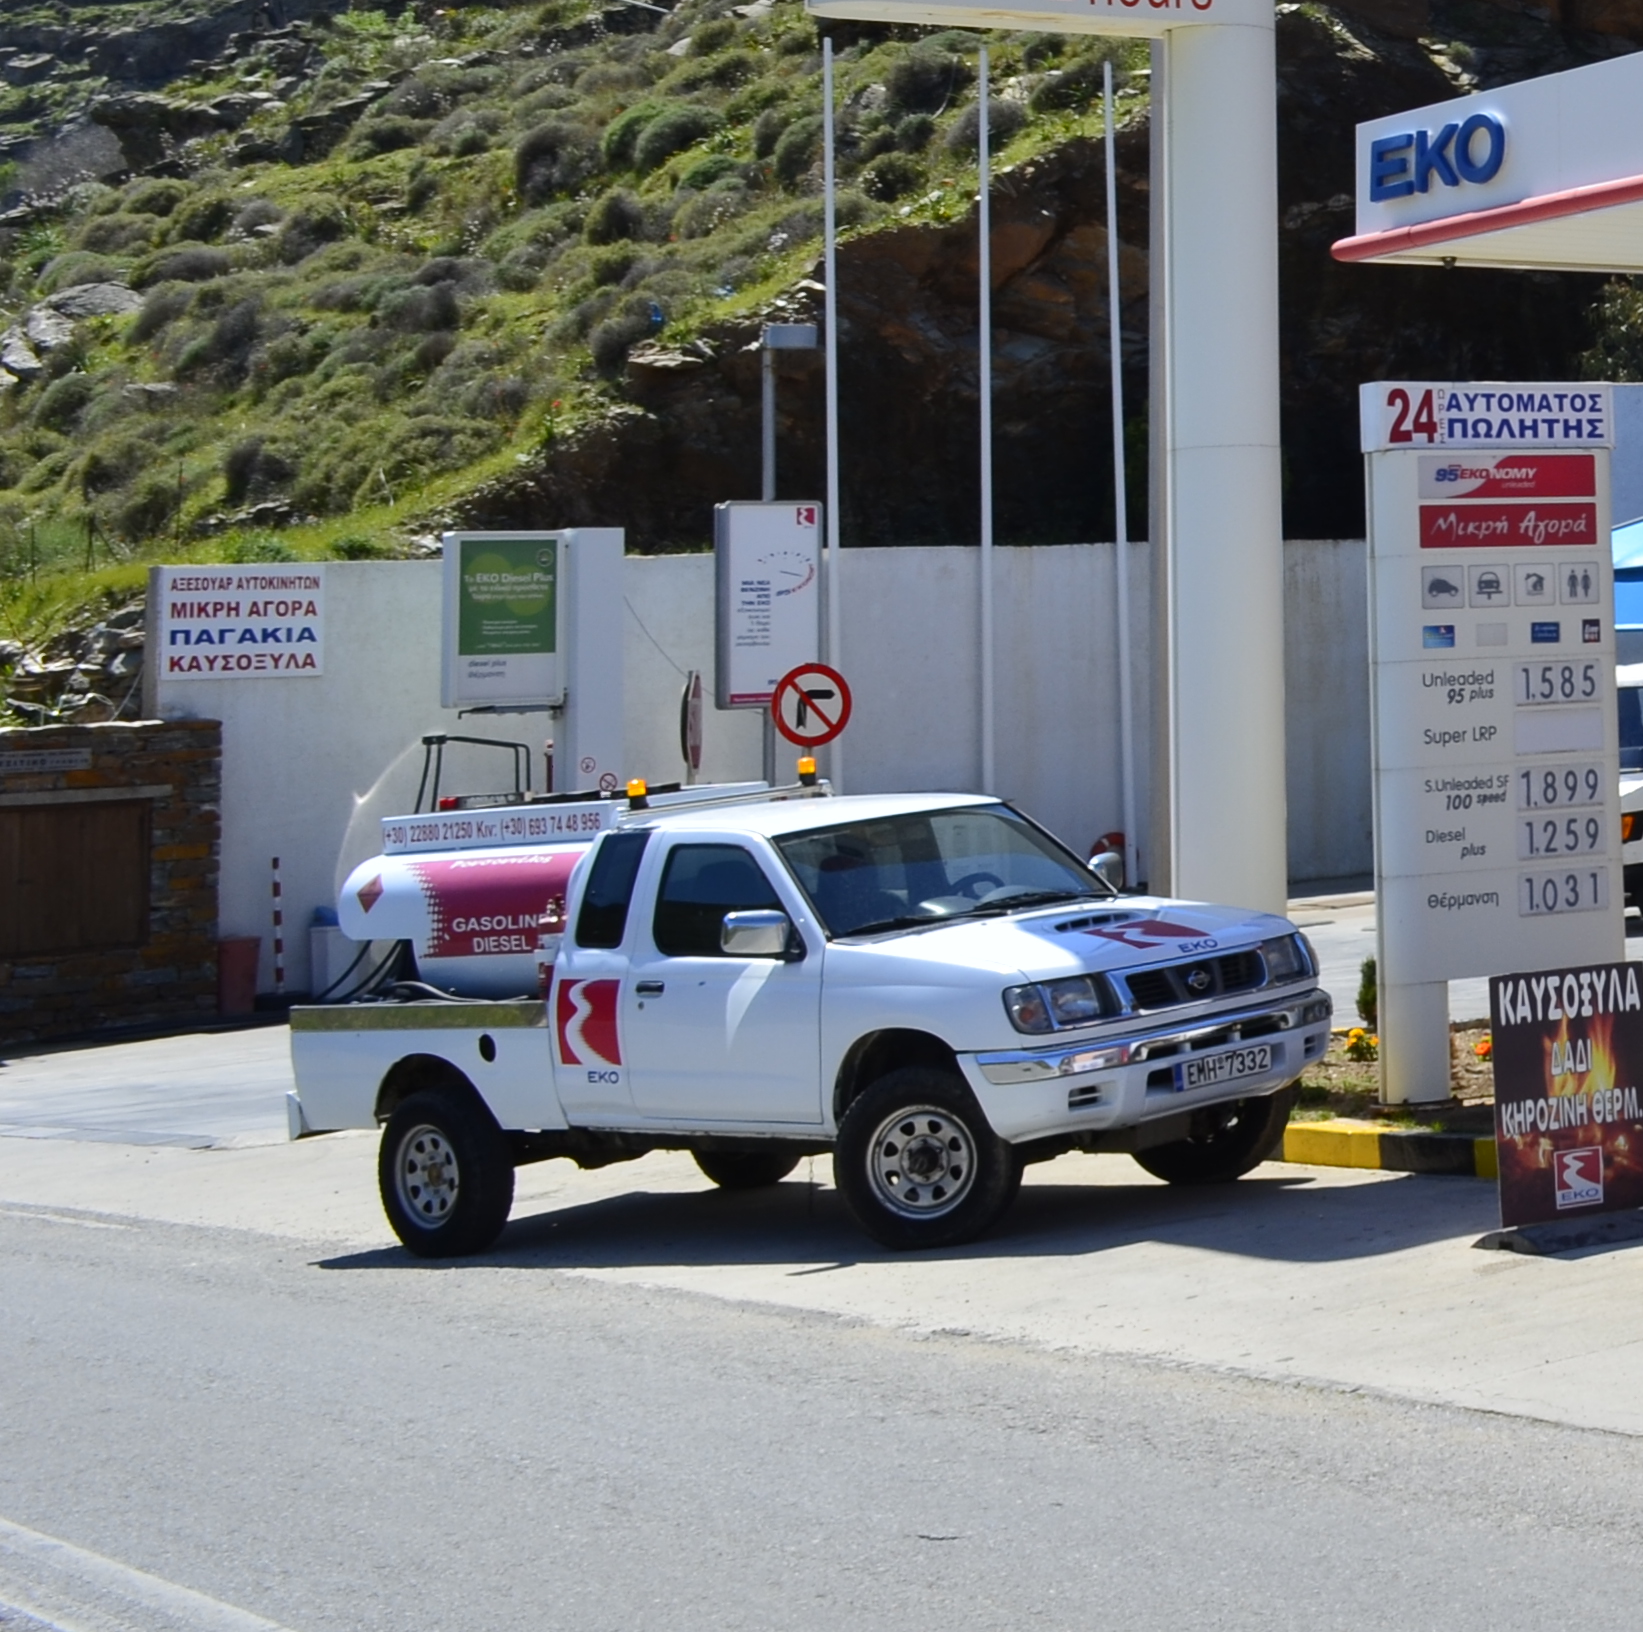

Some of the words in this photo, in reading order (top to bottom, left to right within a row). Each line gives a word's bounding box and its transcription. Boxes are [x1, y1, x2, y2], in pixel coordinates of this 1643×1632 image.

[1370, 113, 1506, 204] EKO
[1446, 393, 1602, 413] ΑΥΤΟΜΑΤΟΣ
[1387, 388, 1438, 443] 24
[1447, 418, 1604, 439] ΠΩΛΗΤΗΣ
[1435, 465, 1537, 482] 95EKONOMY
[1501, 481, 1536, 489] unleaded
[1430, 512, 1508, 541] Μικρή
[1519, 511, 1587, 544] Αγορά
[170, 577, 233, 592] ΑΞΕΣΟΥΑΡ
[236, 576, 320, 591] ΑΥΤΟΚΙΝΗΤΩΝ
[476, 573, 499, 583] EKO
[501, 573, 531, 583] Diesel
[533, 572, 554, 582] Plus
[171, 601, 240, 618] ΜΙΚΡΗ
[248, 600, 317, 617] ΑΓΟΡΑ
[169, 627, 318, 645] ΠΑΓΑΚΙΑ
[169, 653, 316, 672] ΚΑΥΣΟΞΥΛΑ
[1422, 670, 1495, 688] Unleaded
[1447, 688, 1465, 705] 95
[1470, 686, 1495, 702] plus
[1423, 728, 1467, 748] Super
[1473, 726, 1498, 742] LRP
[1424, 775, 1494, 793] S.Unleaded
[1446, 794, 1473, 811] 100
[1476, 789, 1507, 806] speed
[382, 826, 407, 845] (+30)
[410, 823, 440, 843] 22880
[443, 822, 473, 840] 21250
[501, 817, 527, 840] (+30)
[529, 817, 547, 835] 693
[550, 815, 564, 833] 74
[566, 814, 579, 832] 48
[581, 812, 600, 831] 956
[1426, 827, 1466, 843] Diesel
[1461, 842, 1486, 859] plus
[1427, 891, 1499, 911] Θέρμανση
[473, 935, 532, 953] DIESEL
[1178, 938, 1218, 953] EKO
[1498, 967, 1641, 1026] ΚΑΥΣΟΞΥΛΑ
[1551, 1038, 1593, 1076] ΔΑΔΙ
[588, 1071, 619, 1084] EKO
[1501, 1093, 1588, 1136] ΚΗΡΟΖΙΝΗ
[1592, 1087, 1643, 1124] ΘΕΡΜ.
[1561, 1187, 1599, 1202] EKO
